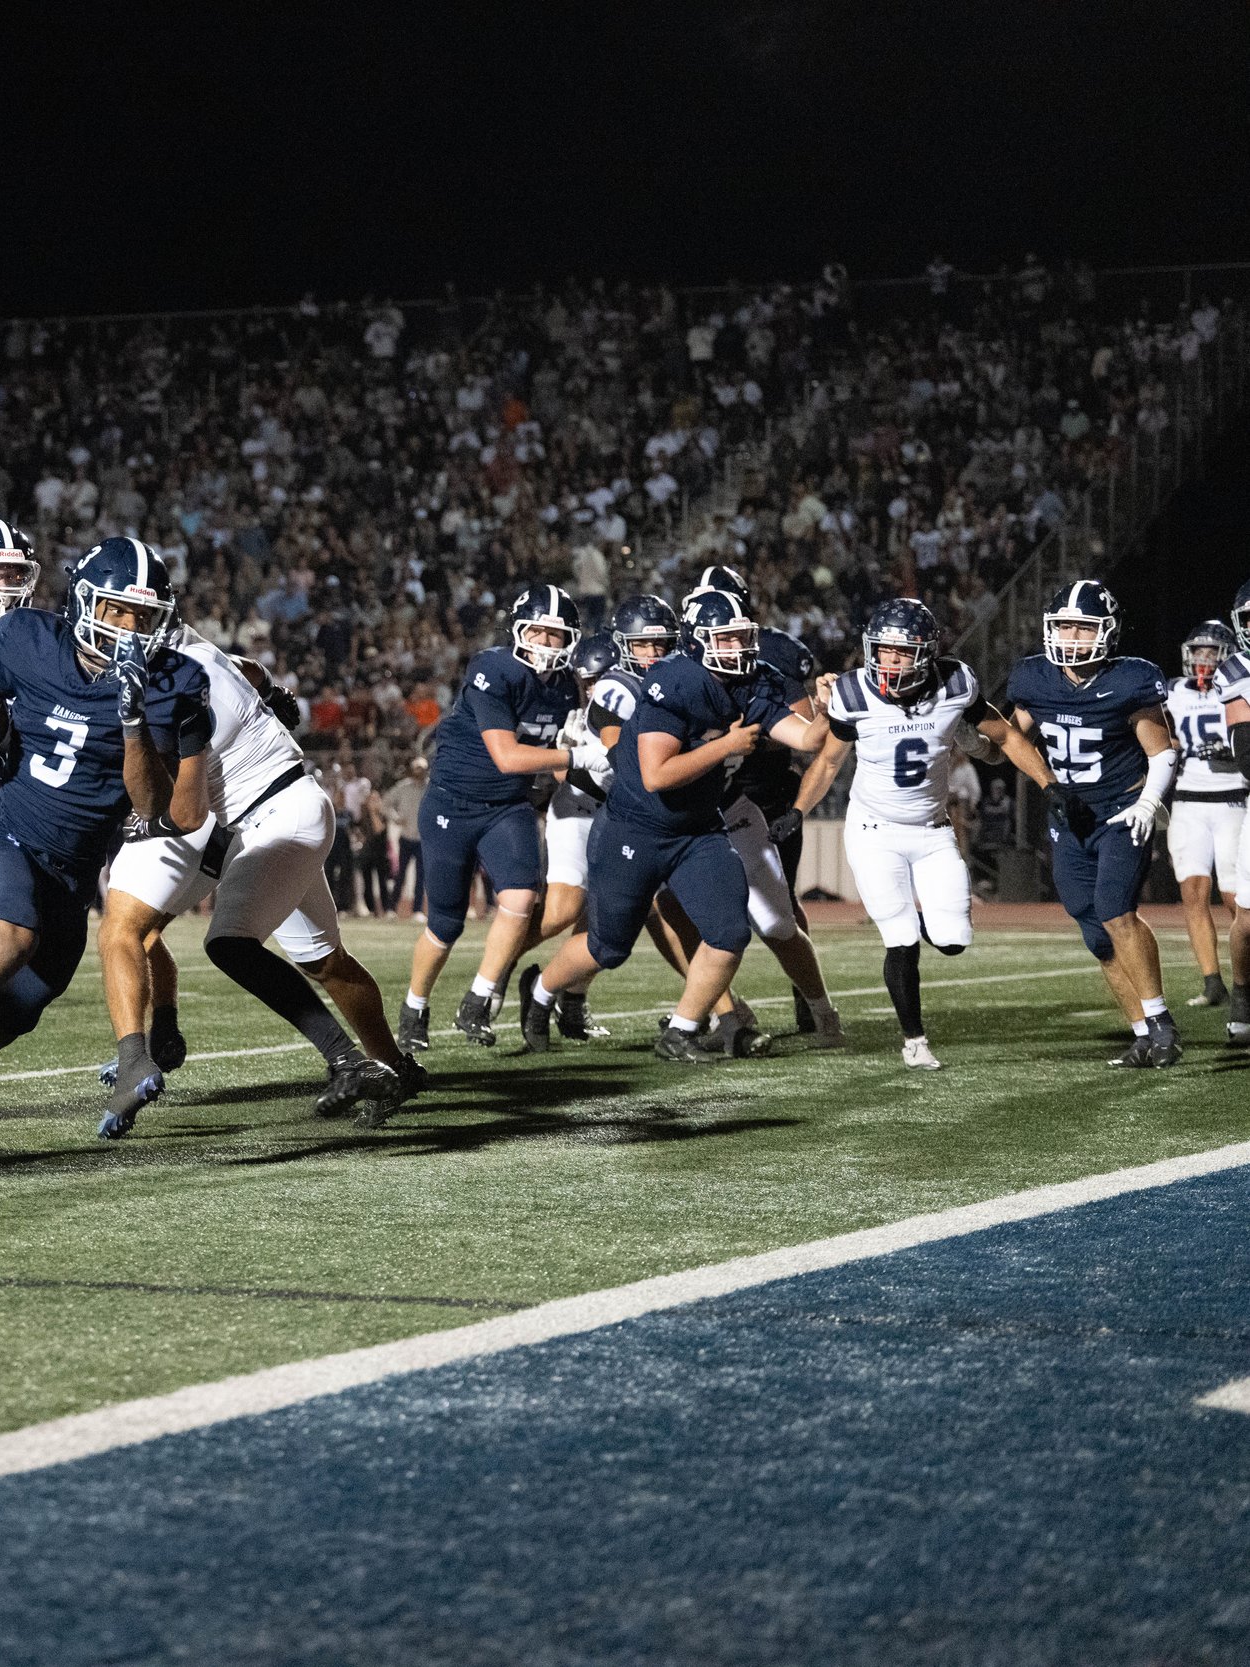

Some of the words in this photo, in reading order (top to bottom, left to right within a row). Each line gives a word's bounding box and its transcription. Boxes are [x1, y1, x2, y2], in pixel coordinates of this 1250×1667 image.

[130, 587, 156, 598] Riddell
[474, 672, 491, 692] SV
[648, 682, 665, 702] SV
[602, 688, 625, 715] 41
[888, 721, 935, 734] CHAMPION
[1056, 713, 1083, 726] RANGERS
[1180, 713, 1222, 758] 15
[29, 716, 90, 789] 3
[893, 737, 929, 788] 6
[1039, 721, 1103, 784] 25
